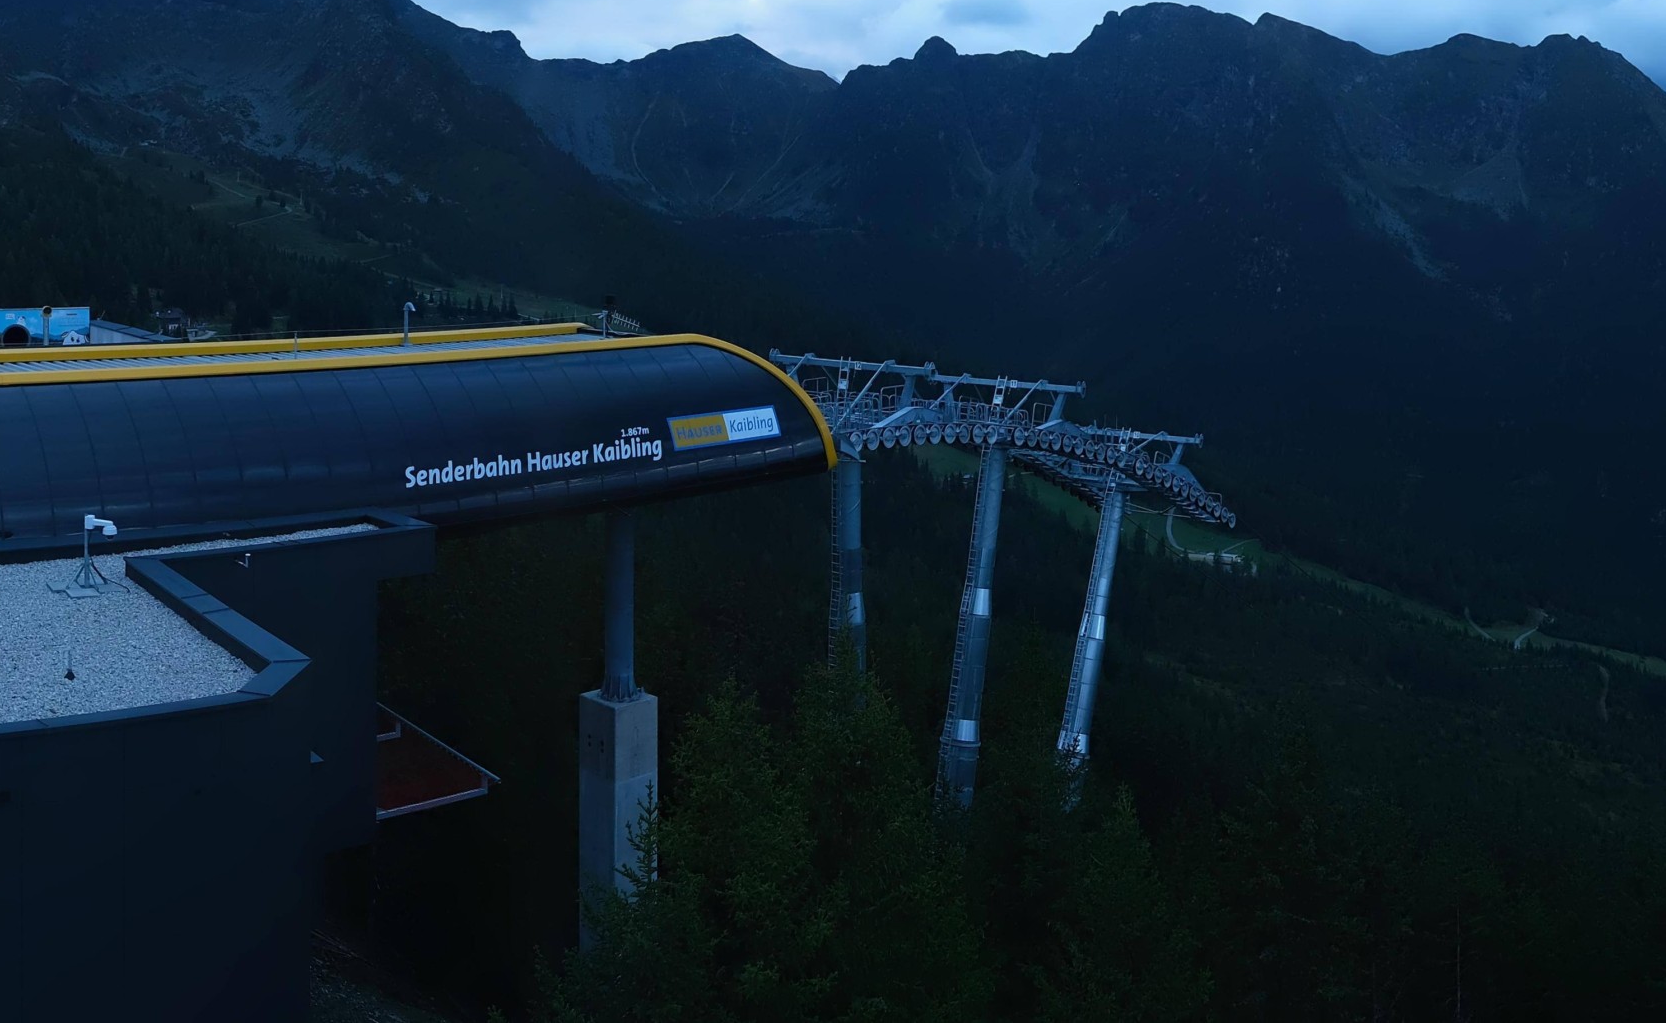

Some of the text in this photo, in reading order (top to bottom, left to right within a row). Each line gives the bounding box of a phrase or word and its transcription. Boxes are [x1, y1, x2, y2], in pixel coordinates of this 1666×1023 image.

[620, 426, 650, 438] 1.867m
[729, 414, 774, 434] Kaibling
[405, 437, 663, 488] Senderbahn Hauser Kaibling
